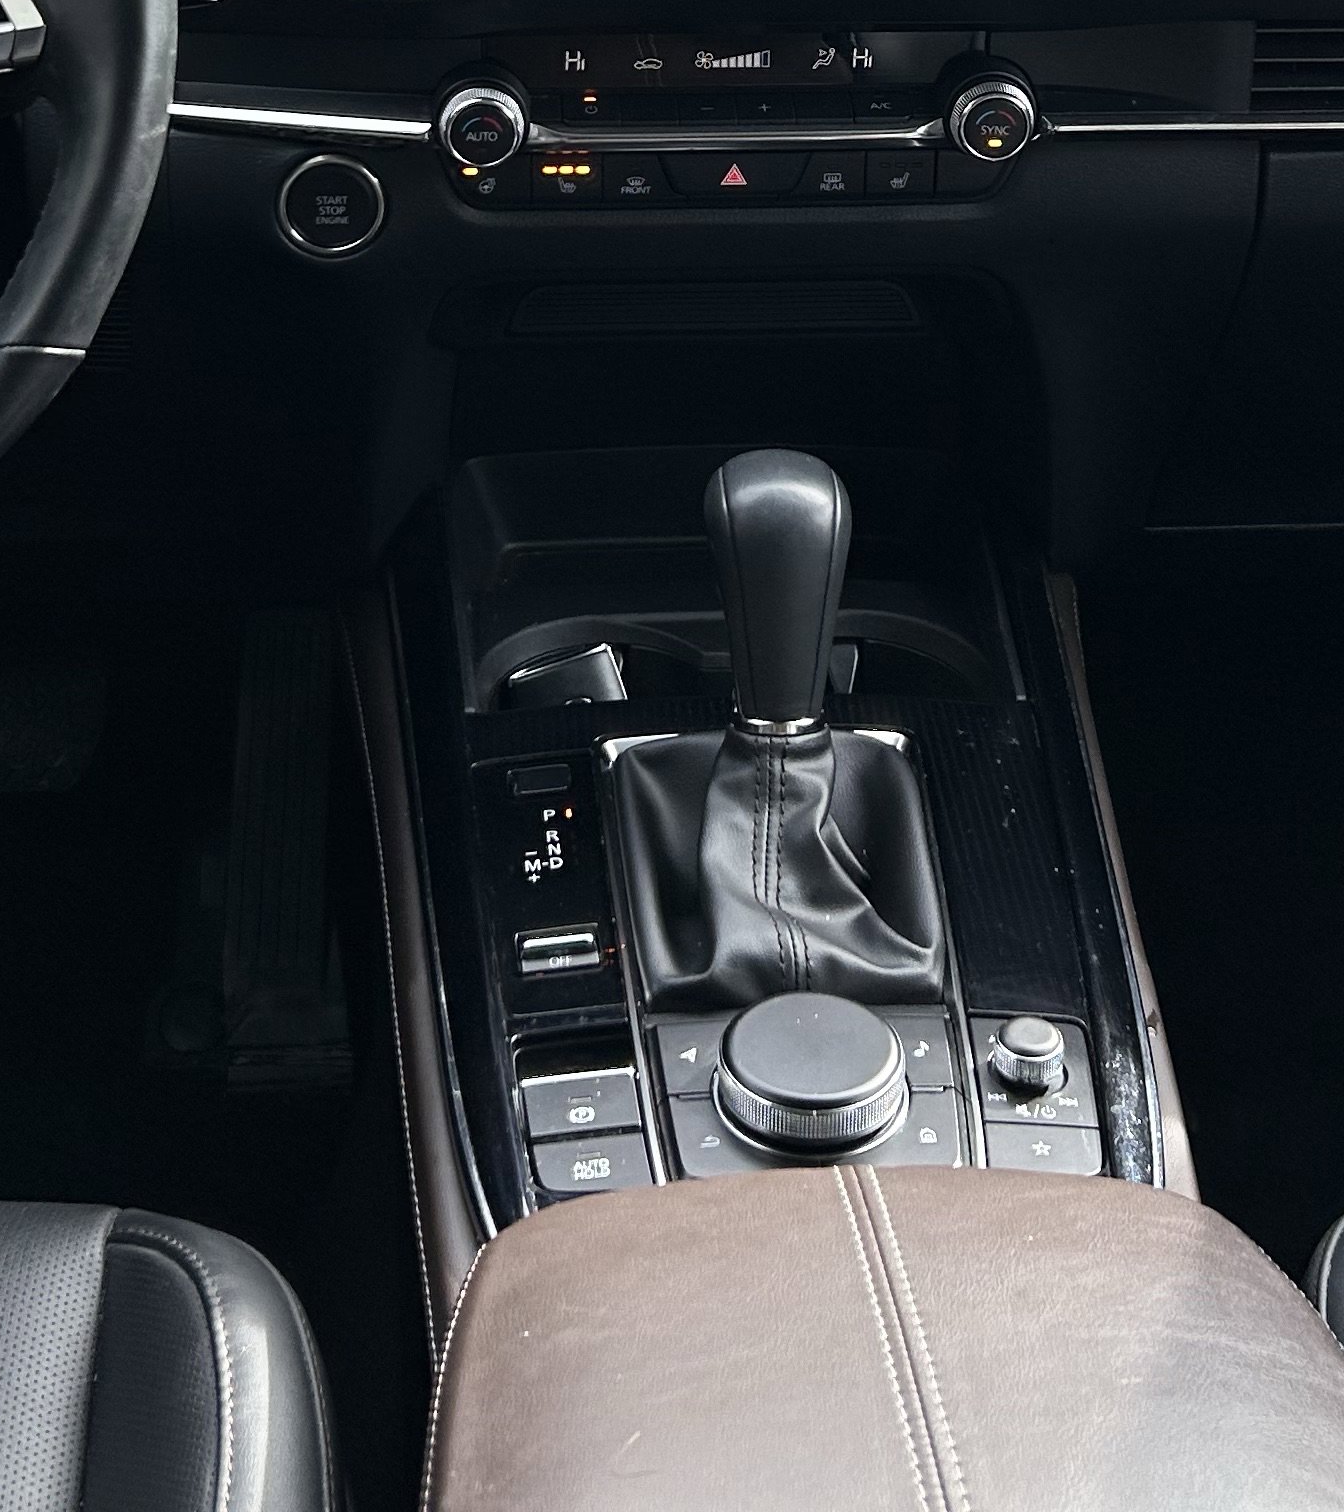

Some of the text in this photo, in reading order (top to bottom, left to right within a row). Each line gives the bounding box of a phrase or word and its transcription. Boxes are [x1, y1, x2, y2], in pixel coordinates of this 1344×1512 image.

[870, 101, 892, 111] A/C
[980, 125, 1010, 136] SYNC
[466, 131, 498, 143] AUTO
[621, 185, 652, 196] FRONT
[820, 182, 845, 191] REAR
[316, 195, 348, 205] START
[320, 206, 347, 216] STOP
[316, 216, 350, 225] ENGINE
[543, 809, 556, 822] P
[546, 830, 560, 843] R
[547, 842, 562, 856] N
[549, 956, 573, 968] OFF
[574, 1158, 610, 1170] AUTO
